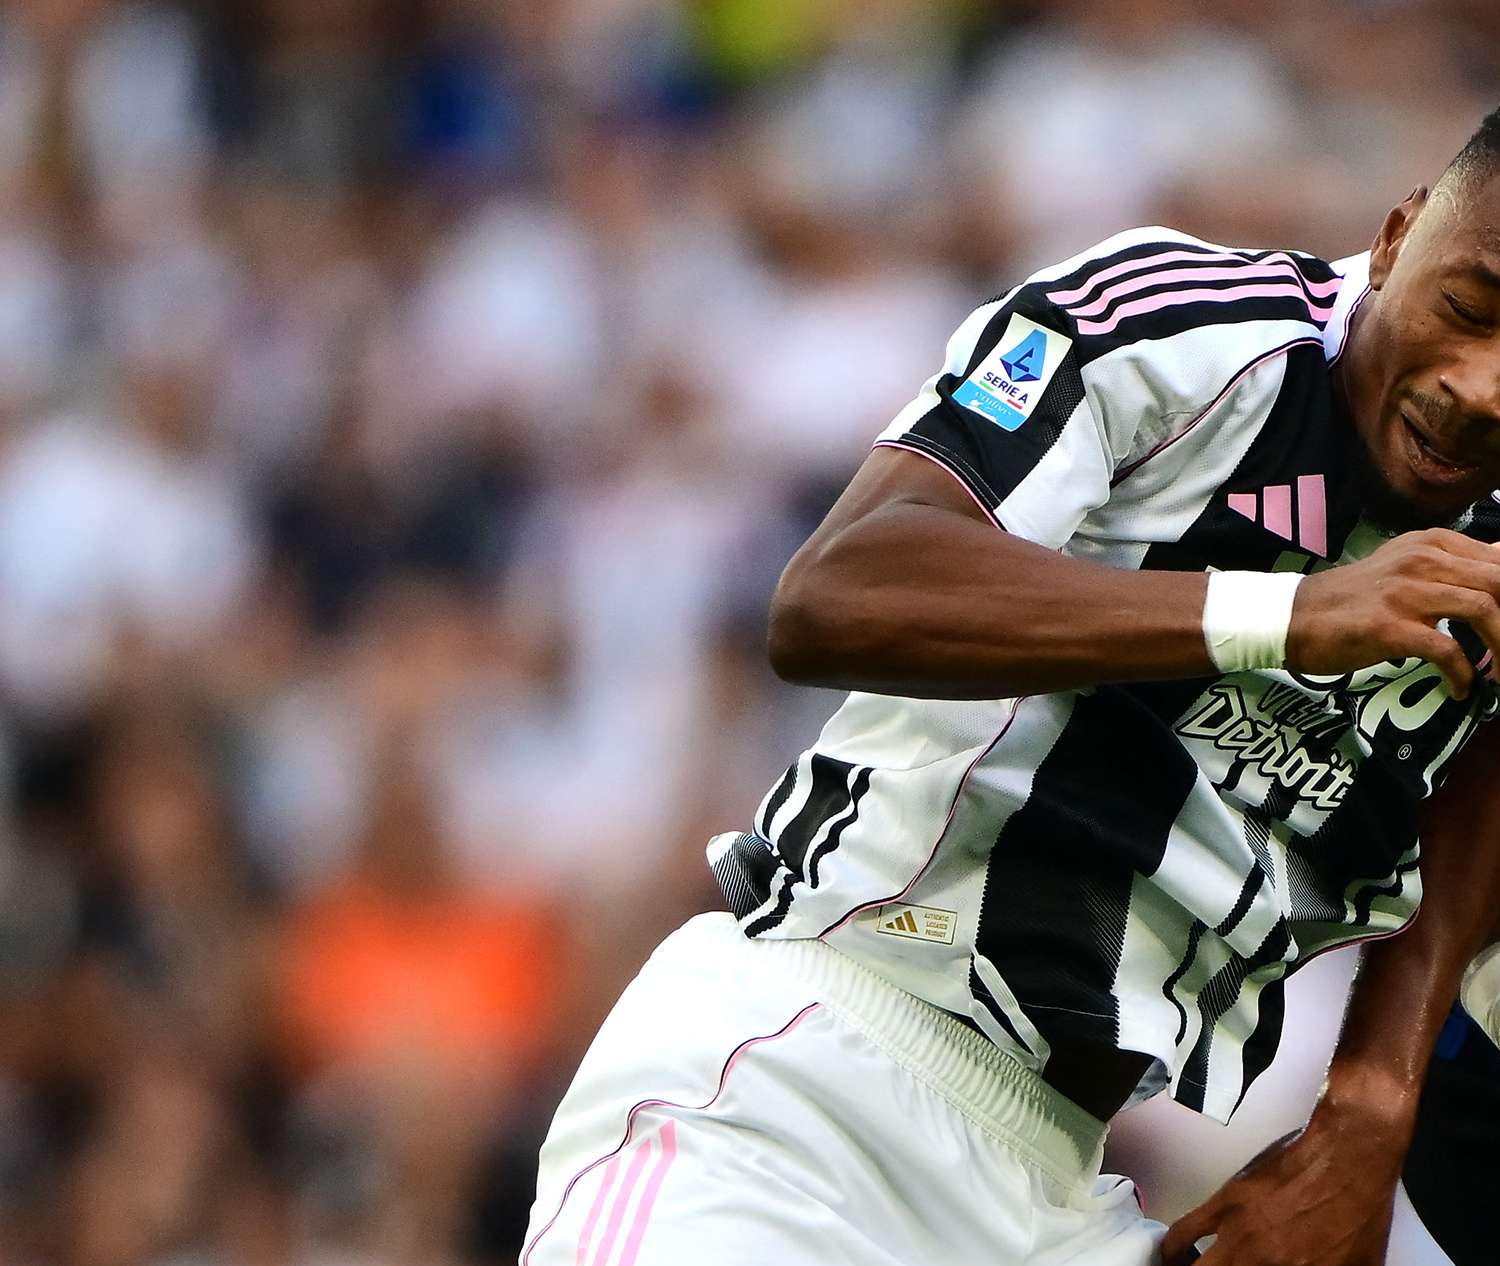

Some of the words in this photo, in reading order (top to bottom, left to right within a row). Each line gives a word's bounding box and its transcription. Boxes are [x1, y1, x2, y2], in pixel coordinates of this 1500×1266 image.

[983, 371, 1020, 398] SERIE
[1018, 393, 1029, 405] A
[1176, 685, 1355, 809] Detroit
